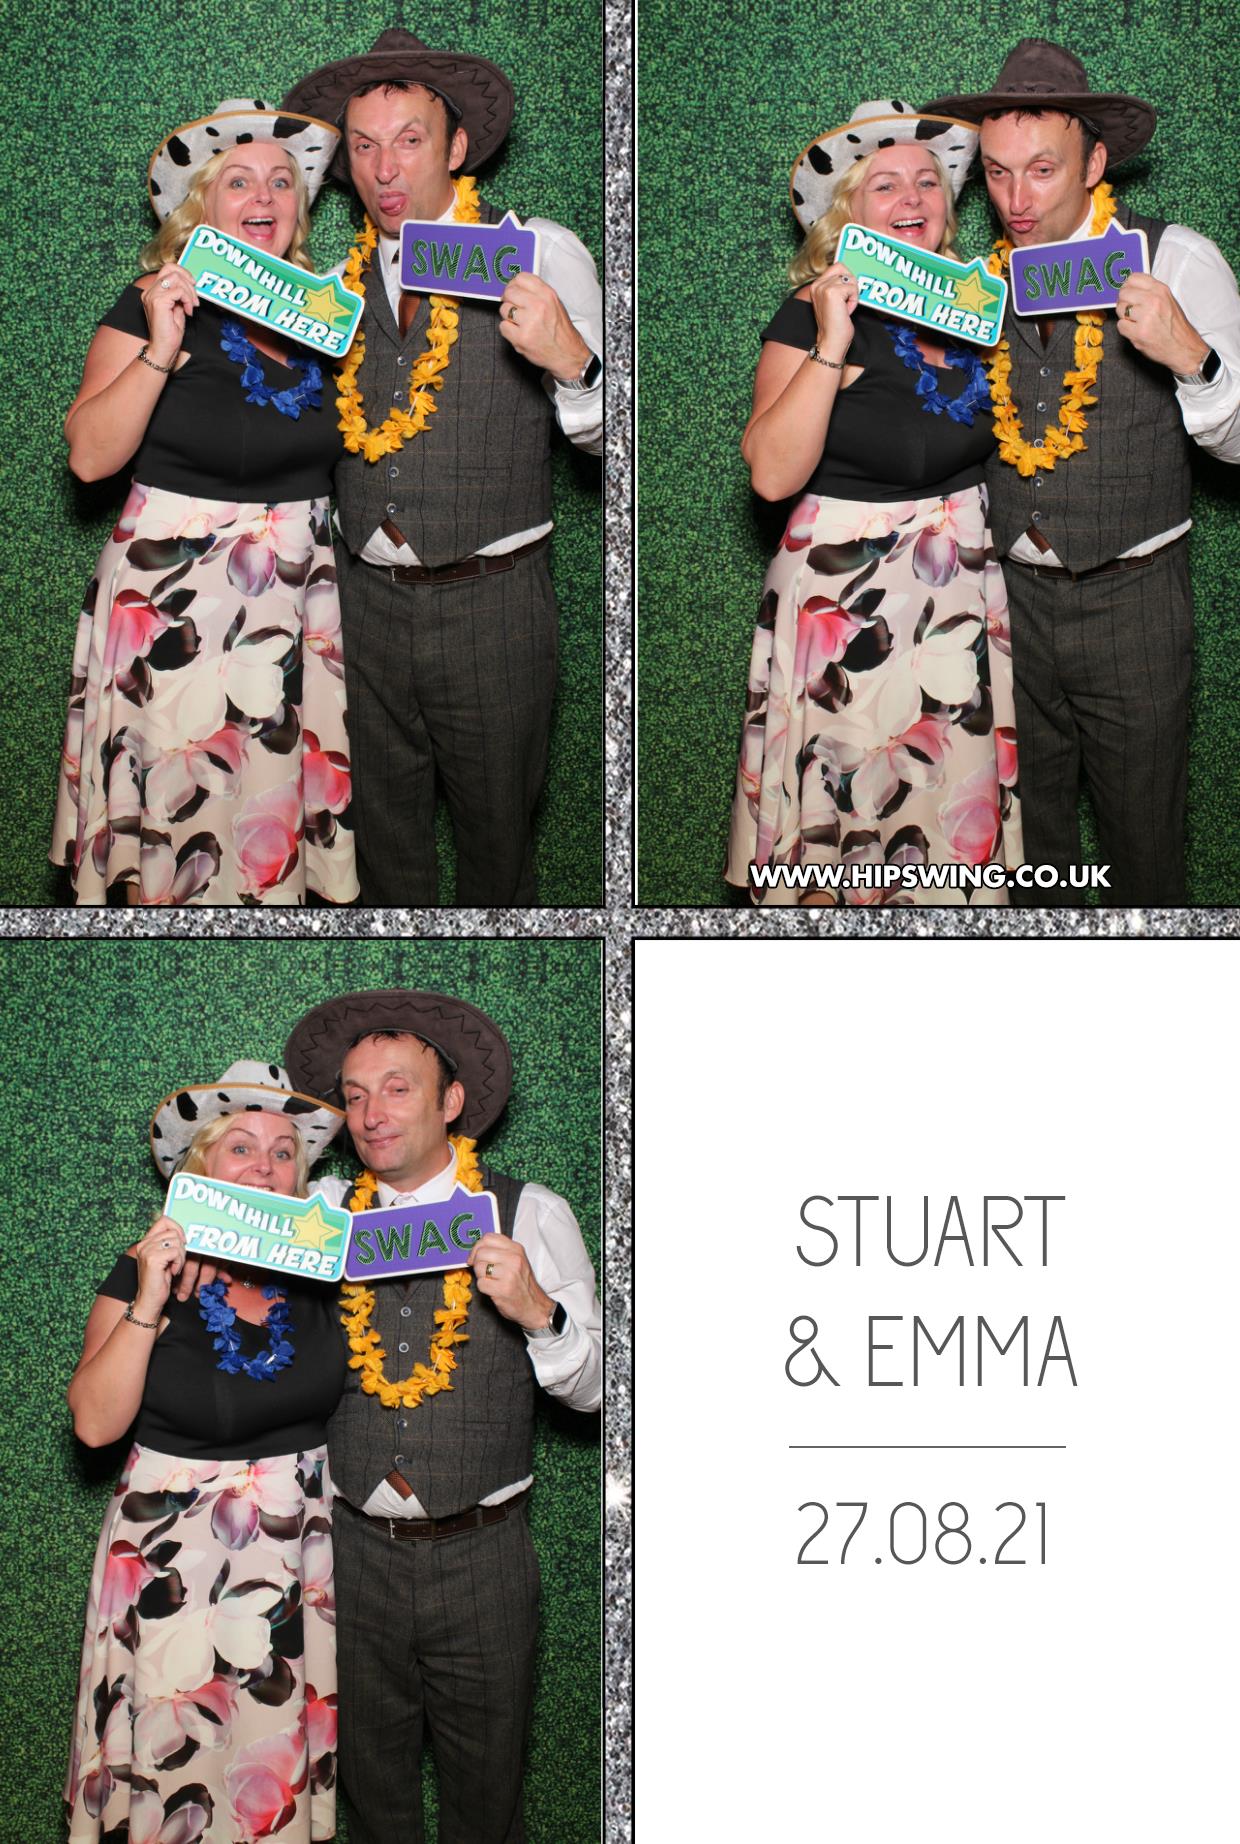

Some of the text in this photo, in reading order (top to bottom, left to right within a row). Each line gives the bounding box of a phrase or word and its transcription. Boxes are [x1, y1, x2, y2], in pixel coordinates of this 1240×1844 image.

[194, 229, 307, 306] DOWNHILL
[411, 239, 522, 285] SWAG
[844, 228, 957, 299] DOWNHILL
[1023, 251, 1131, 300] SWAG
[195, 271, 346, 351] FROM HERE
[857, 278, 995, 341] FROM HERE
[173, 1177, 297, 1238] DOWNHILL
[186, 1223, 340, 1276] FROM HERE
[353, 1212, 481, 1265] SWAG
